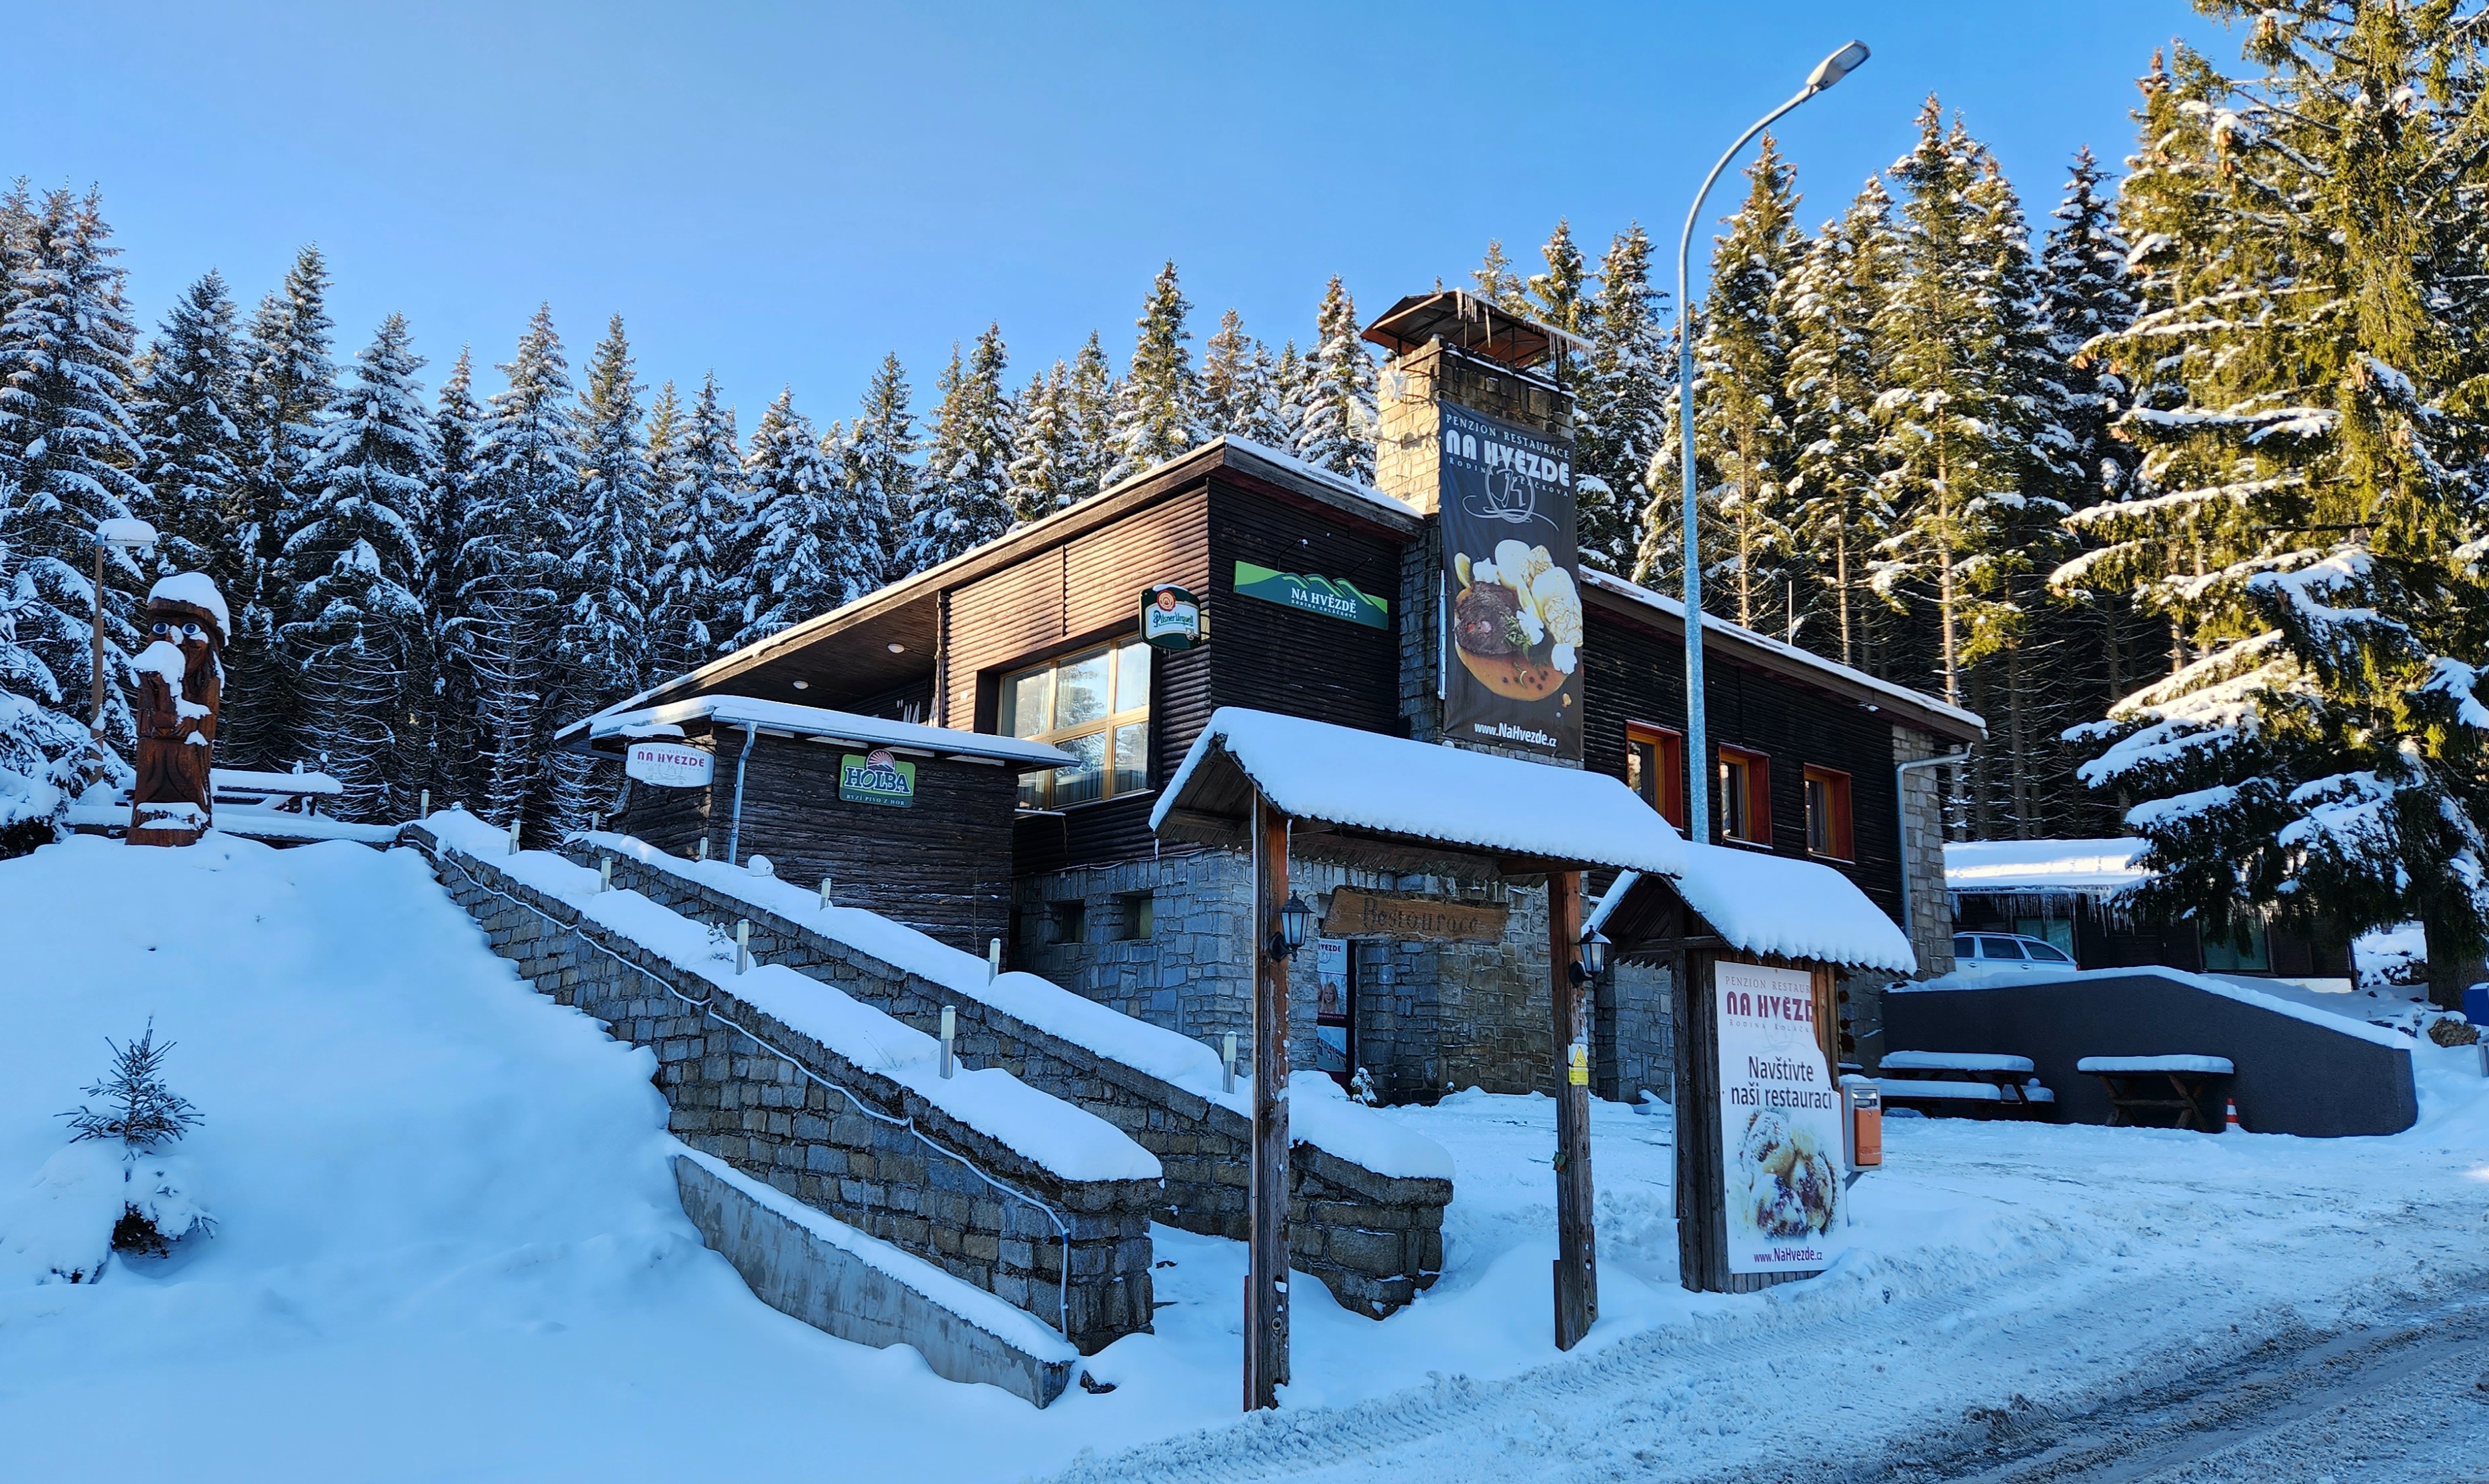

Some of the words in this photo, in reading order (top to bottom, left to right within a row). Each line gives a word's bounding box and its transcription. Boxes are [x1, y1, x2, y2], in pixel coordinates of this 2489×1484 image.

[1446, 414, 1496, 437] PENZION
[1503, 431, 1570, 460] RESTAURACE
[1446, 429, 1477, 460] NA
[1449, 456, 1494, 476] RODINA
[1290, 587, 1308, 602] NA
[1310, 592, 1356, 614] HVĚZDĚ
[1153, 610, 1176, 628] Pilsner
[1175, 612, 1194, 626] Urquell
[1474, 722, 1557, 748] www.NaHvezde.cz
[637, 751, 653, 762] NA
[844, 766, 911, 794] HOLBA
[1725, 976, 1766, 989] PENZION
[1726, 991, 1751, 1016] NA
[1729, 1019, 1766, 1029] RODINA
[1748, 1056, 1814, 1082] Navštivte
[1731, 1081, 1760, 1106] naši
[1766, 1086, 1832, 1110] restauraci
[1753, 1246, 1823, 1263] www.NaHvezde.cz
